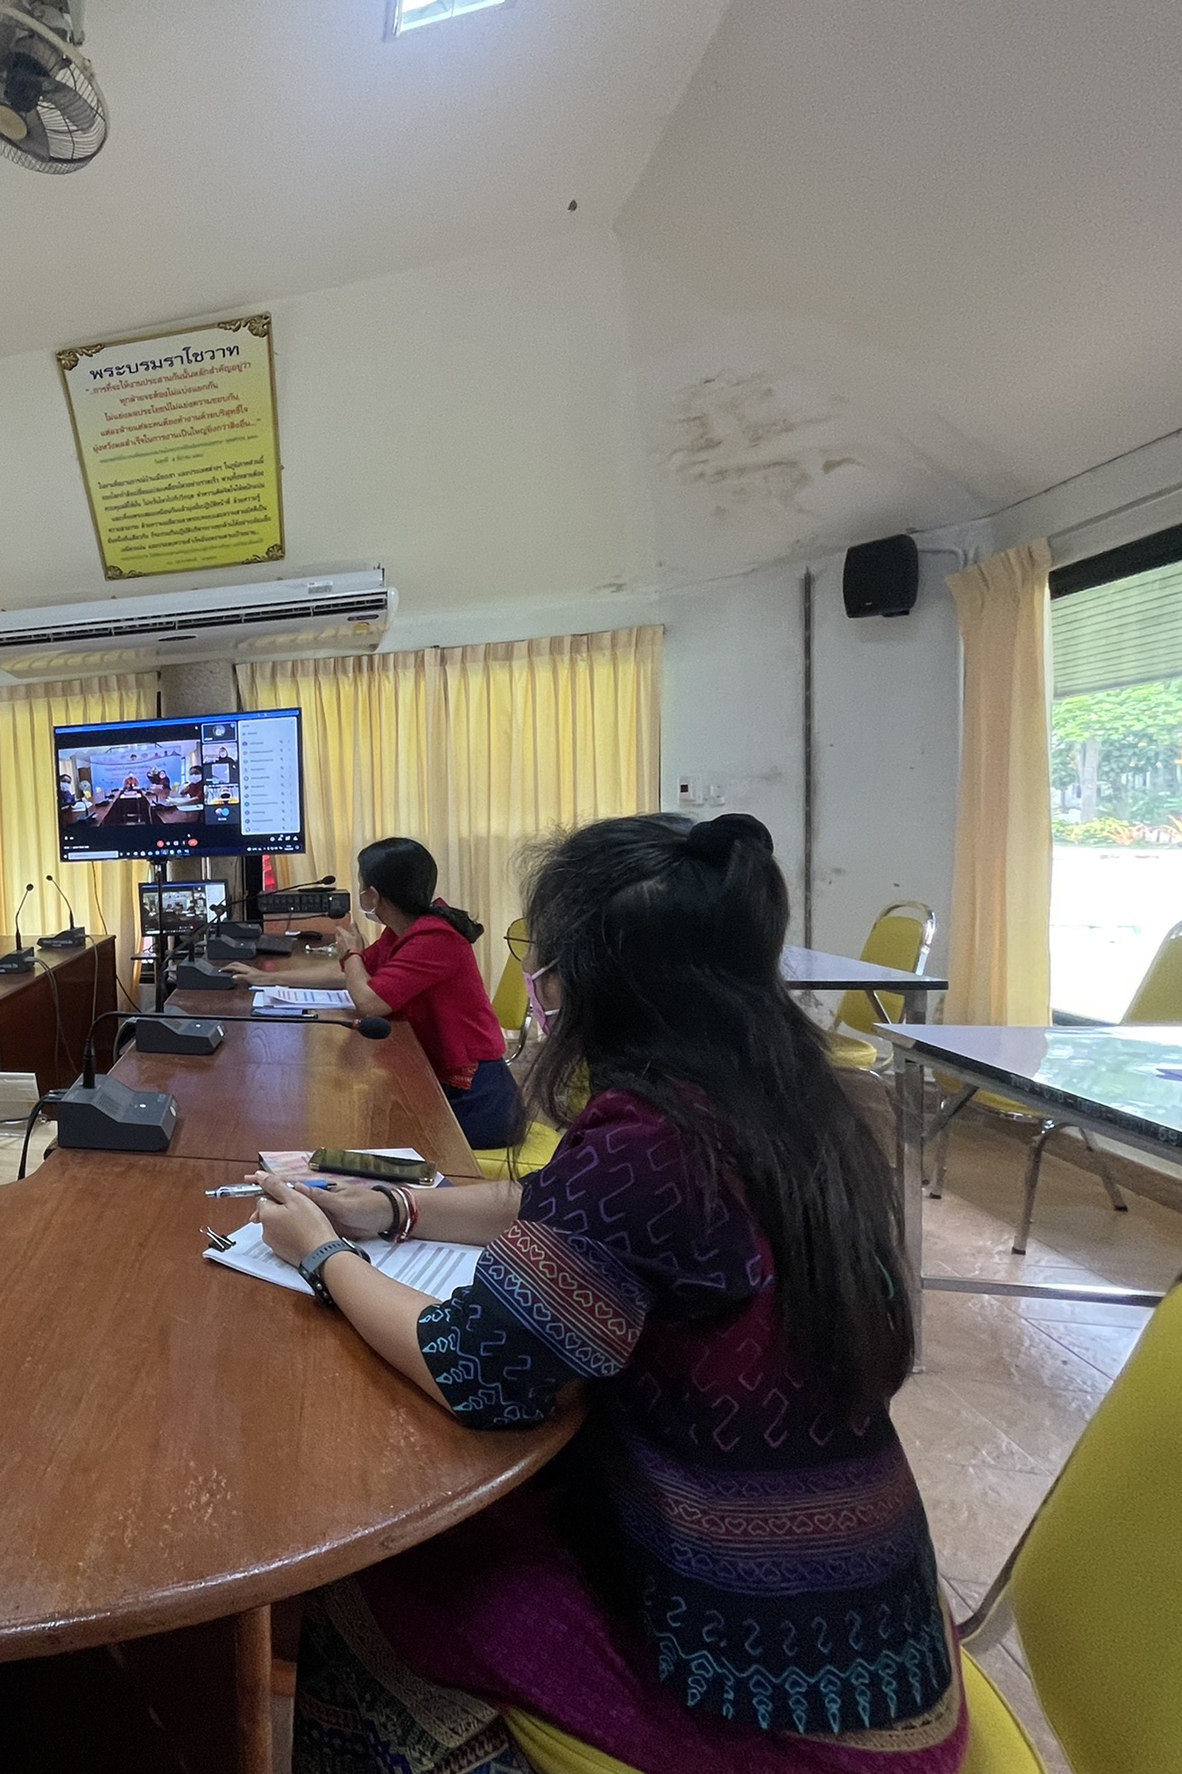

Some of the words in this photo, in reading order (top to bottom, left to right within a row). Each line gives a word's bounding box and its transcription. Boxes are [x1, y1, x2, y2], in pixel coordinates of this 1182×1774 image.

[89, 344, 240, 380] พระบรมราโชวาท
